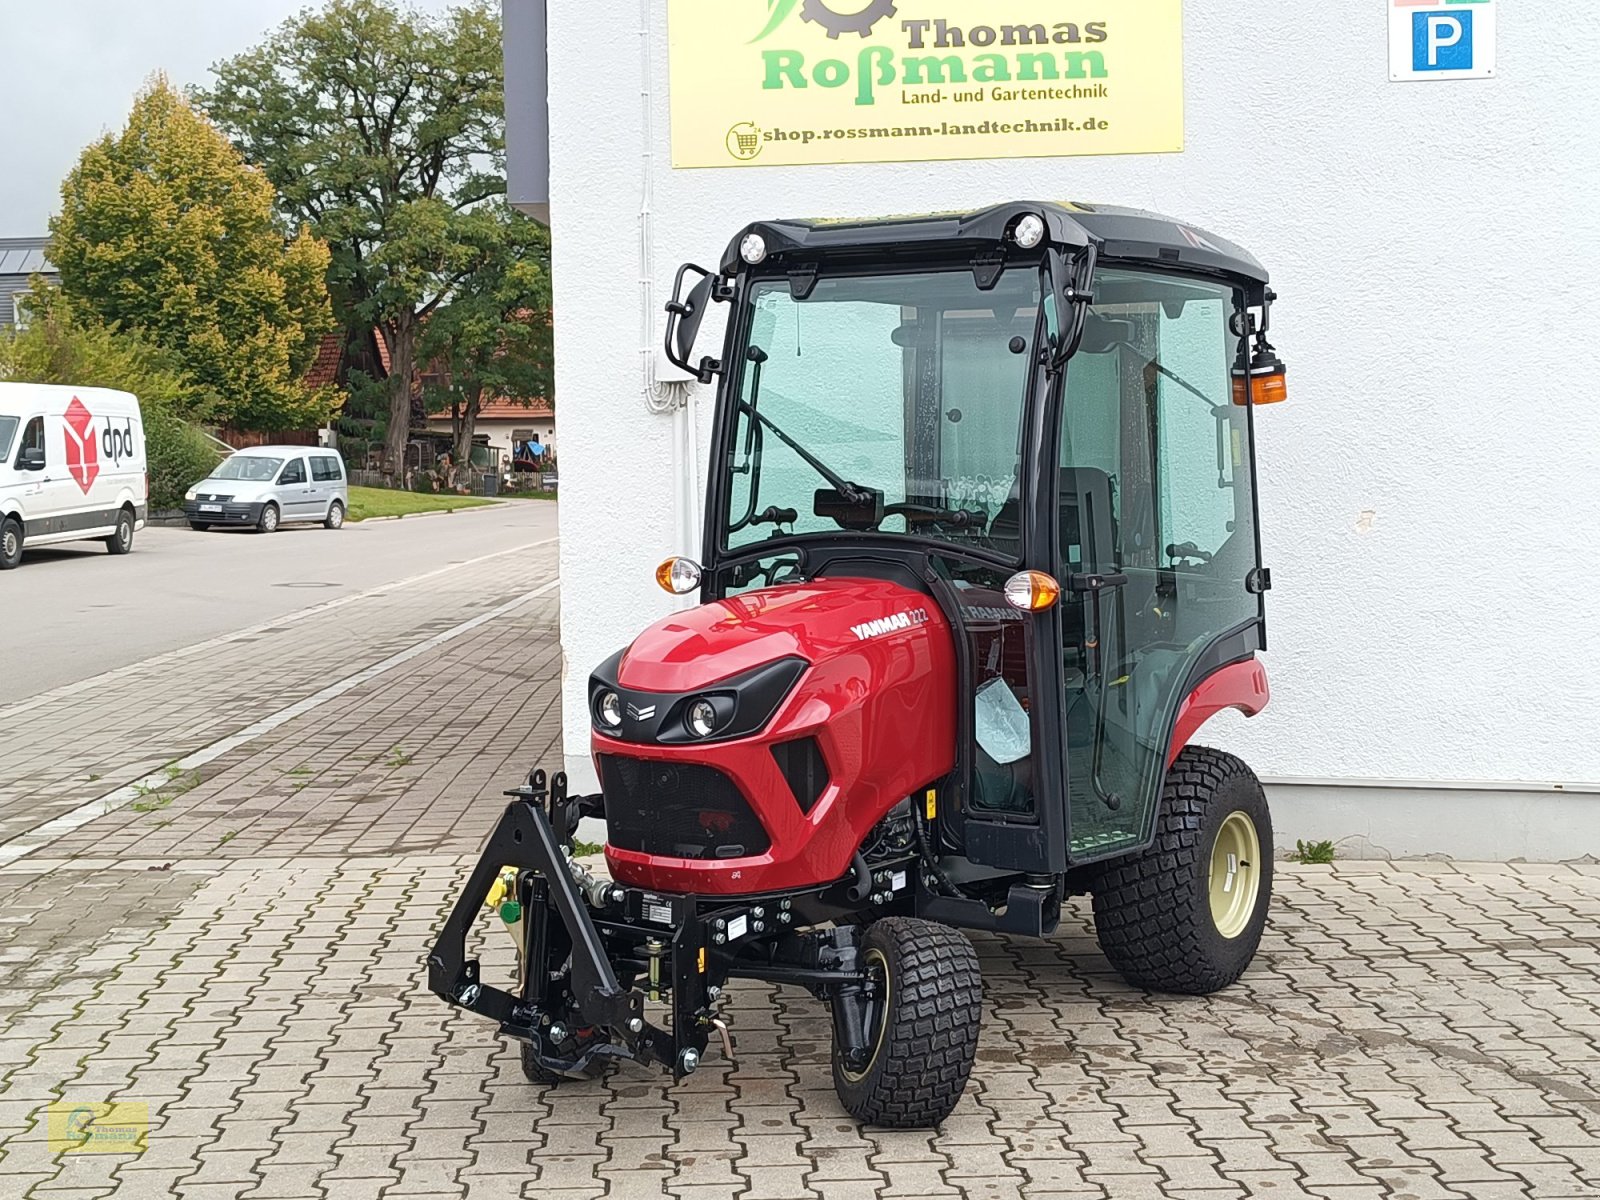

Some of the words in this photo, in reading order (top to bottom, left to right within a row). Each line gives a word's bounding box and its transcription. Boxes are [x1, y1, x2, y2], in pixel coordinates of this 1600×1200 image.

[901, 18, 1108, 49] Thomas
[1427, 15, 1463, 66] P
[761, 45, 1108, 106] Roßmann
[901, 89, 948, 104] Land-
[953, 88, 984, 102] und
[991, 83, 1108, 101] Gartentechnik
[763, 117, 1109, 144] shop.rossmann-landtechnik.de
[102, 416, 133, 468] dpd
[850, 612, 911, 641] YANMAR
[909, 608, 929, 624] 222
